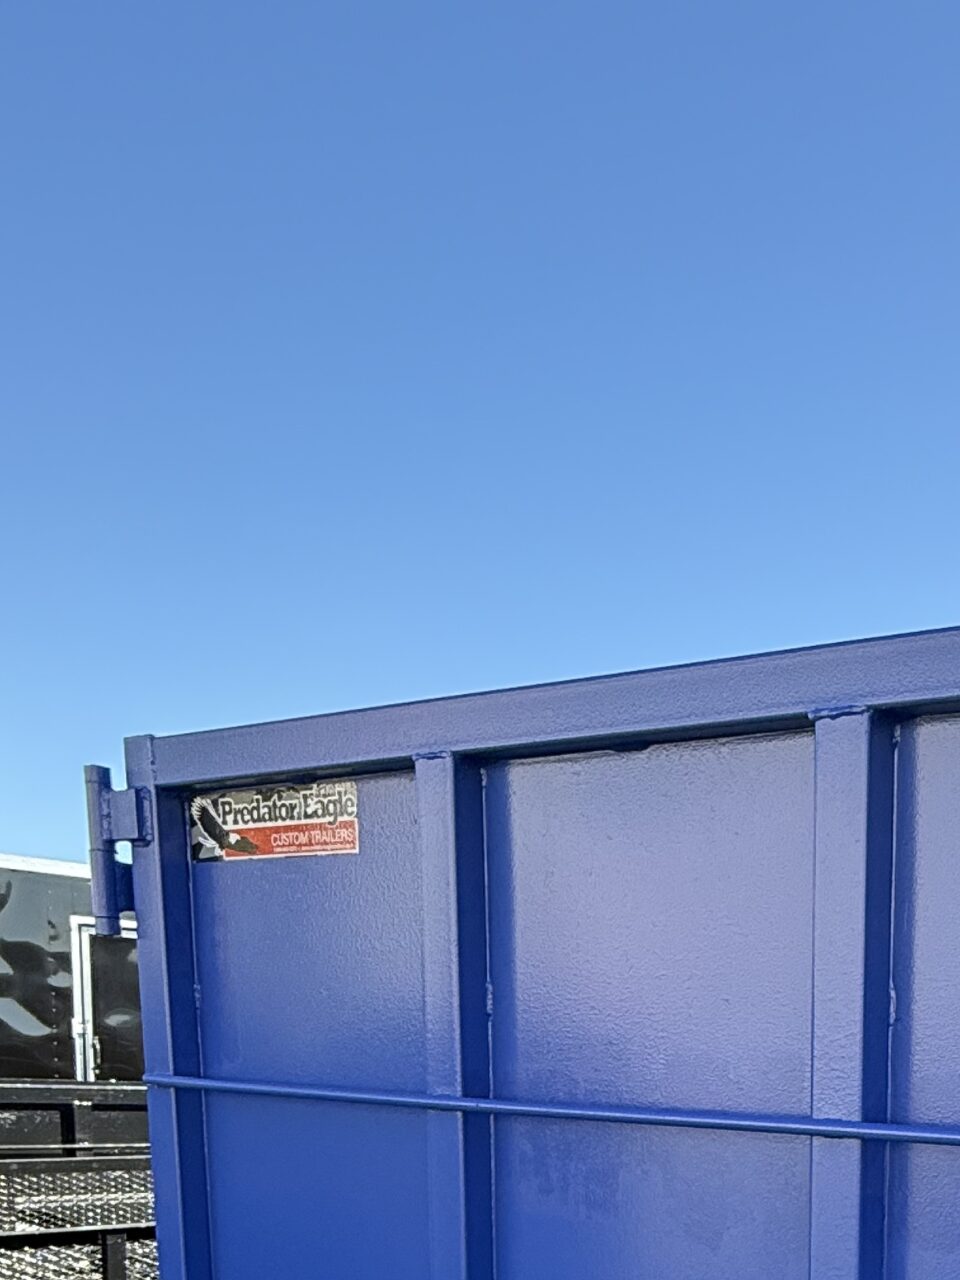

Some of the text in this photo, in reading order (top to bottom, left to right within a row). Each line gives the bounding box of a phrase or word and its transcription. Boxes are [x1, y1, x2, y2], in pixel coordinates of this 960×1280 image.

[219, 788, 357, 826] Predator Eagle
[271, 828, 354, 847] CUSTOM TRAILERS
